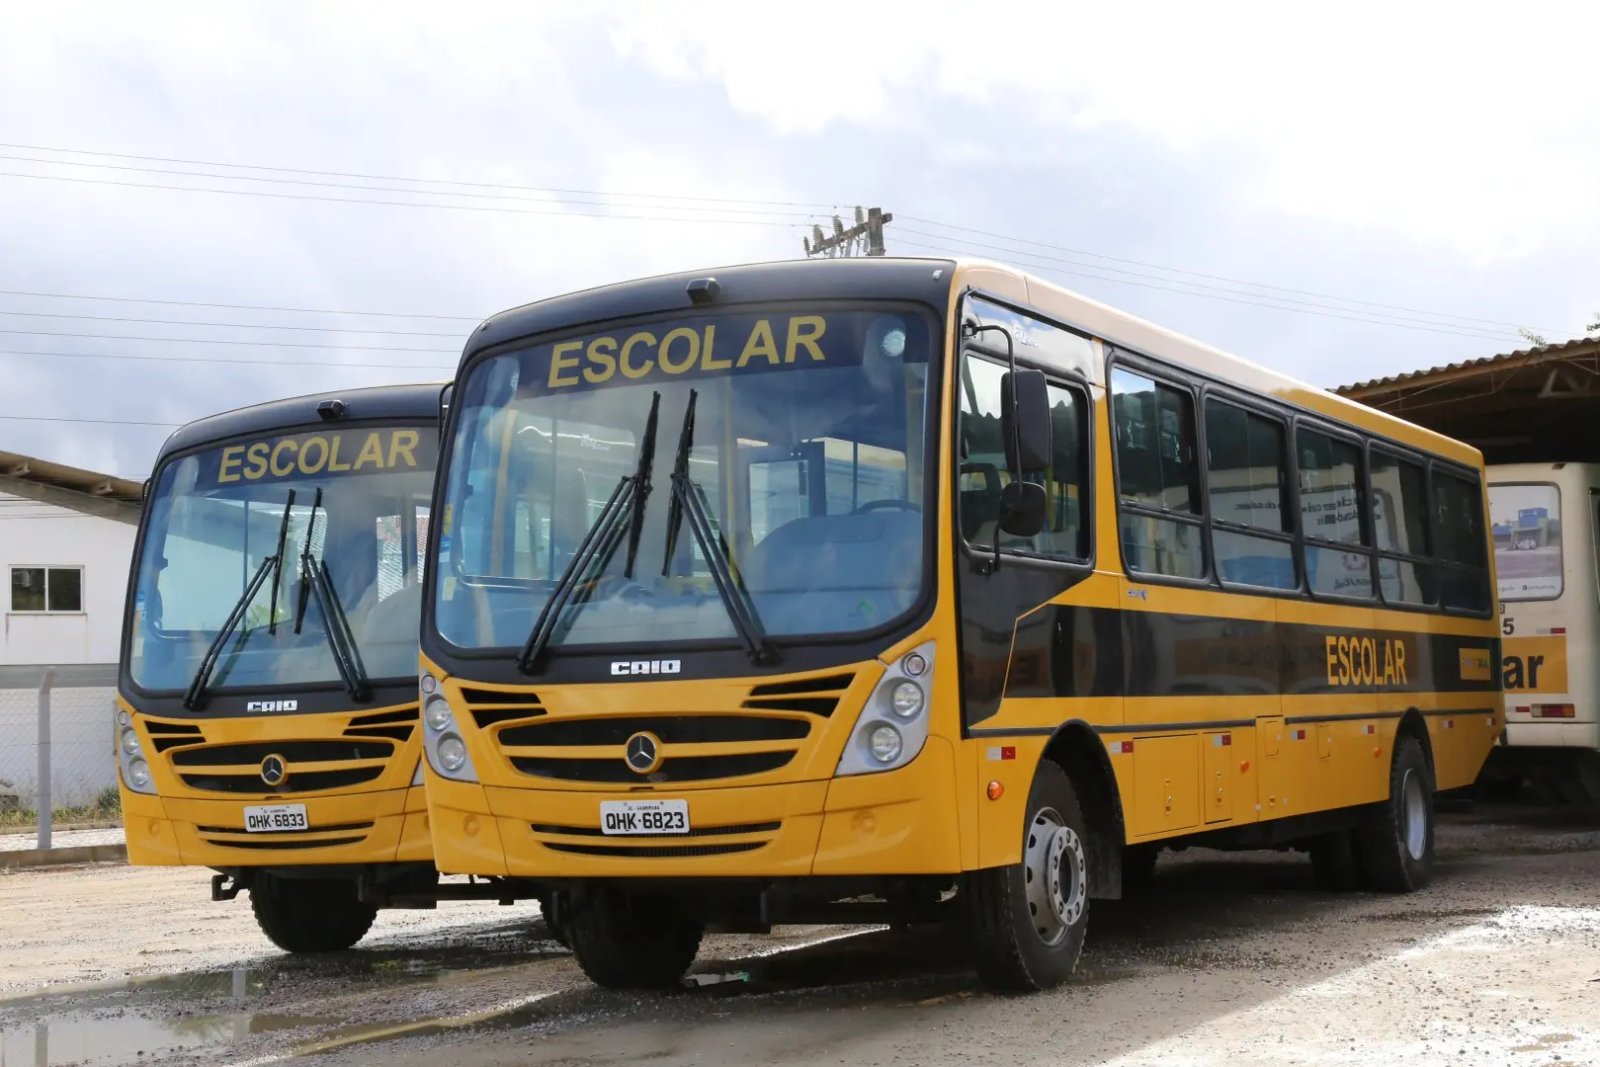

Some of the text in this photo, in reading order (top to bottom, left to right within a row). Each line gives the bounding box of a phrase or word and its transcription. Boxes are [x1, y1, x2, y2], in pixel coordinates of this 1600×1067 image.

[547, 315, 827, 388] ESCOLAR
[217, 430, 420, 483] ESCOLAR
[611, 659, 681, 676] CAIO
[1325, 635, 1408, 686] ESCOLAR
[247, 699, 298, 712] CAIO
